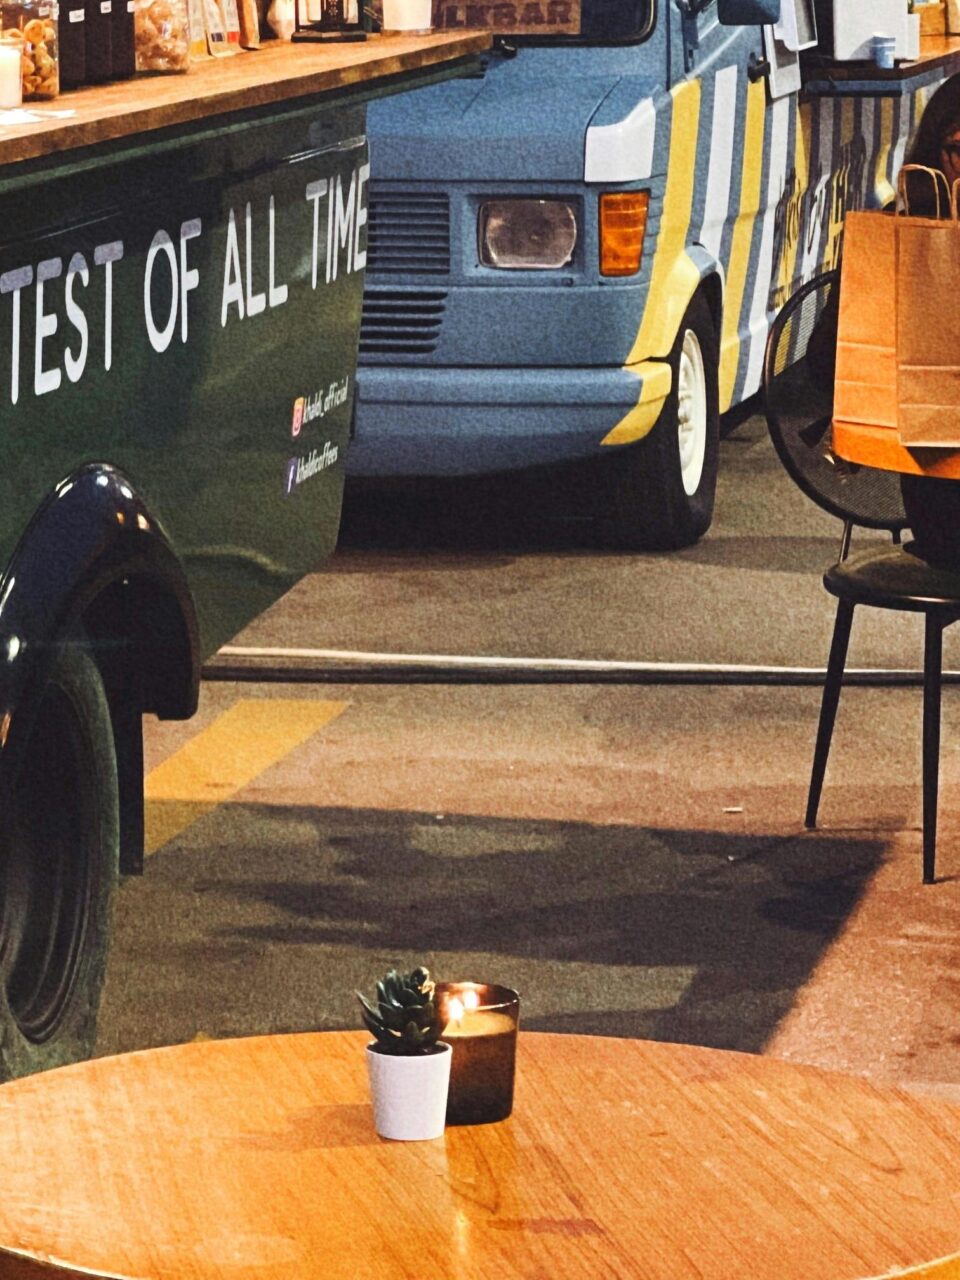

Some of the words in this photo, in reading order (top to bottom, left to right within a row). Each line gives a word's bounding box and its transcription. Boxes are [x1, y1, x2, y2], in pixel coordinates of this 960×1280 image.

[143, 216, 202, 354] OF
[220, 194, 289, 328] ALL
[305, 160, 370, 292] TIME
